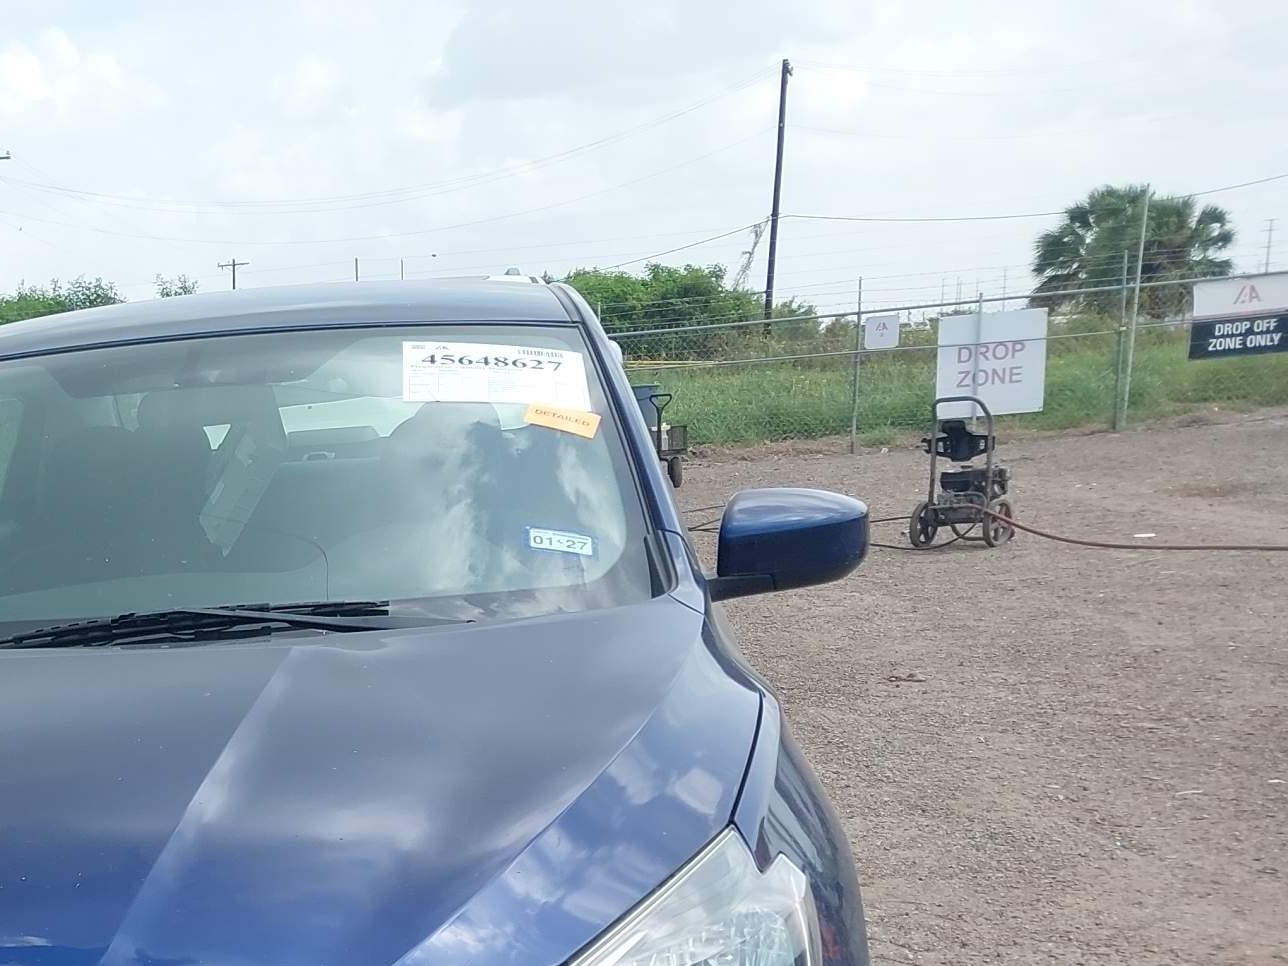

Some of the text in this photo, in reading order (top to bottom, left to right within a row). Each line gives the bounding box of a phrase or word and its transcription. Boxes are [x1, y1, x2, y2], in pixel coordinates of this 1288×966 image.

[1215, 318, 1279, 336] DROP OFF
[1208, 332, 1283, 351] ZONE ONLY
[421, 353, 562, 371] 45648627
[957, 341, 1026, 364] DROP
[956, 366, 1023, 388] ZONE
[534, 408, 590, 427] DETAILED
